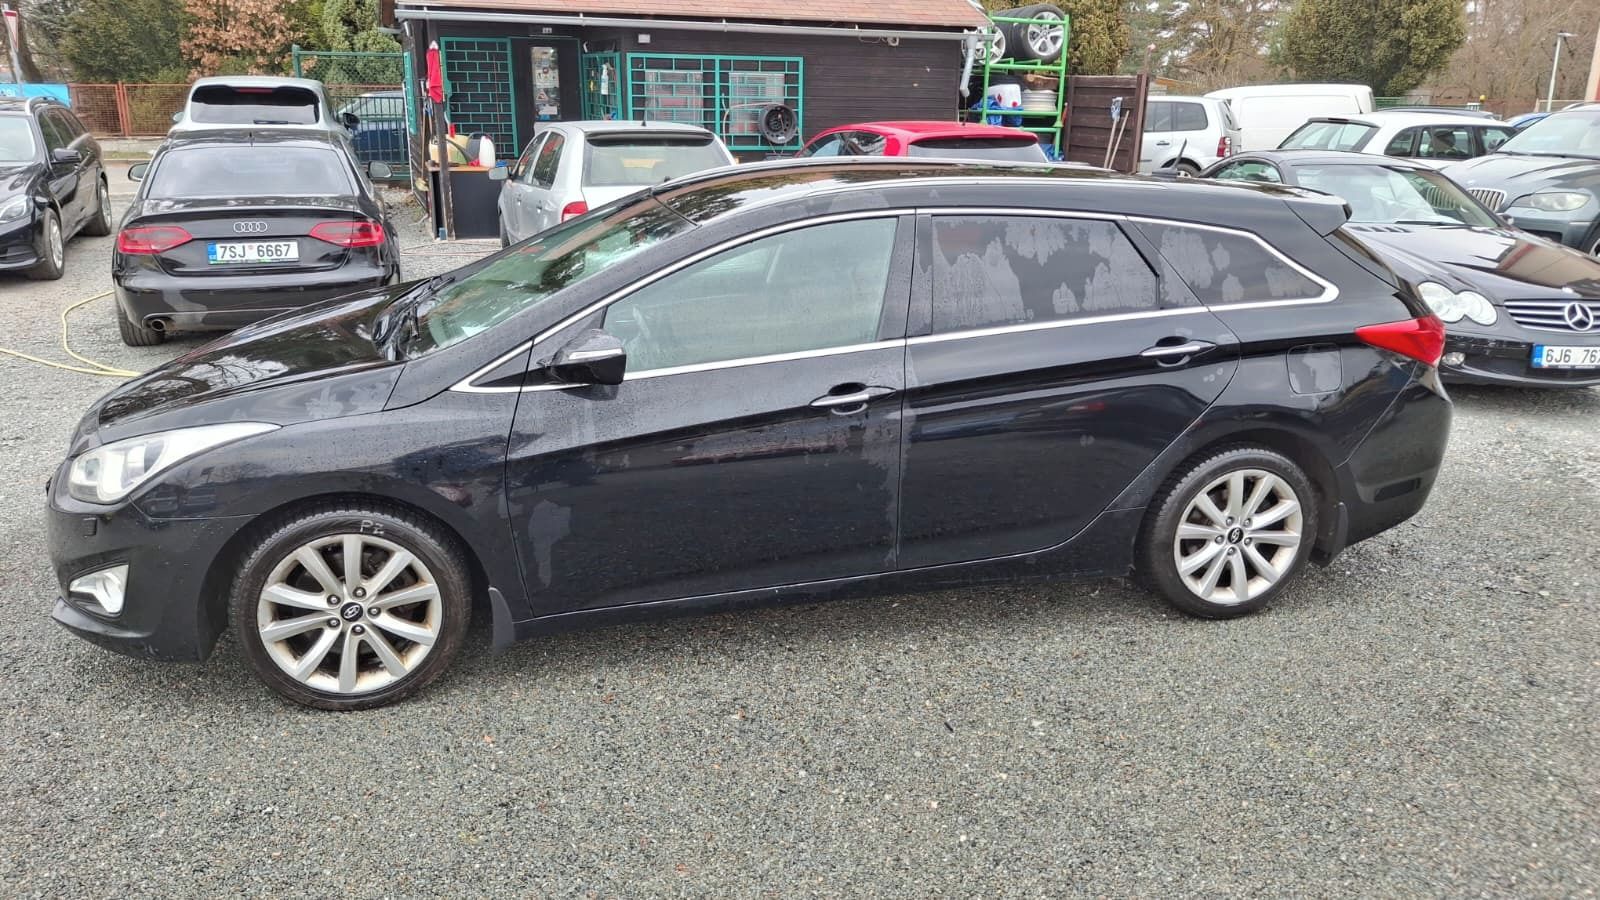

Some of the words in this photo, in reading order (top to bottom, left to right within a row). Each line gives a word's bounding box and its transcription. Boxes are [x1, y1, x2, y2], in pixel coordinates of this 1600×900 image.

[219, 245, 246, 259] 7SJ
[256, 243, 291, 258] 6667
[1545, 348, 1572, 363] 6J6
